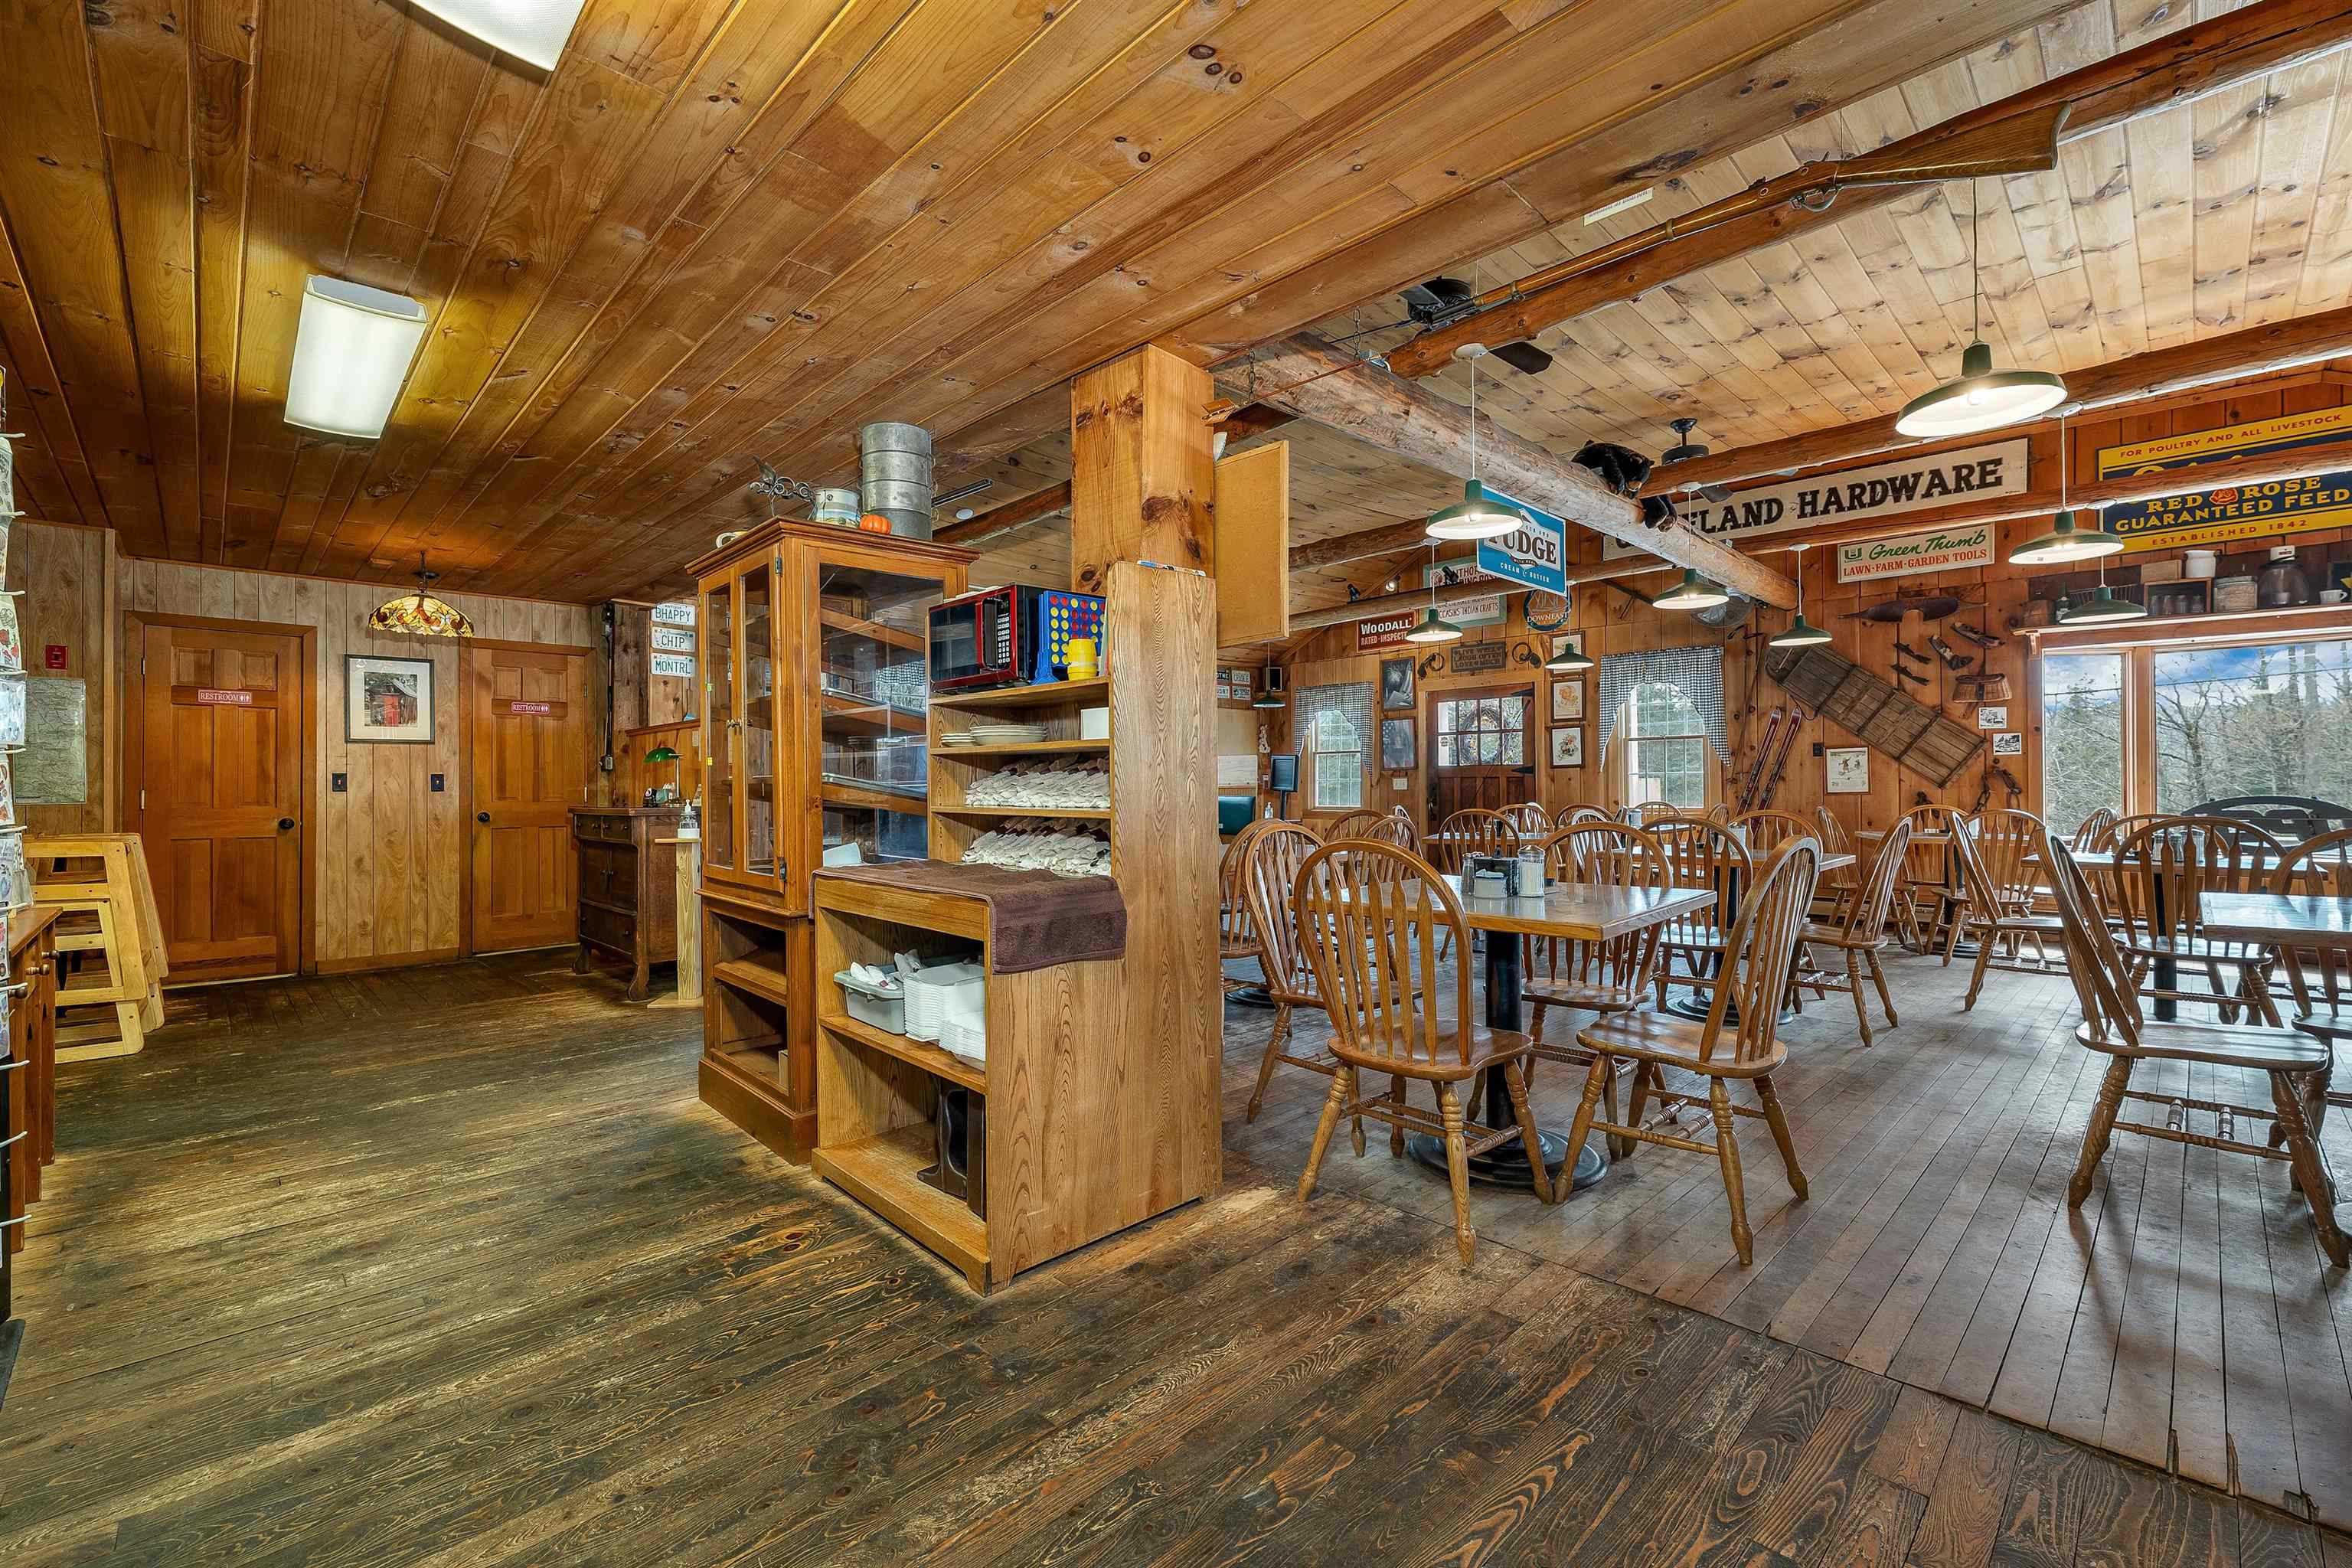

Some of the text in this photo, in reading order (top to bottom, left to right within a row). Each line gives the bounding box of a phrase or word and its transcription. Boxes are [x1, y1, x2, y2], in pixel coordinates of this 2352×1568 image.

[2120, 413, 2341, 458] FOR POULTRY AND ALL LIVESTOCK
[1797, 456, 2004, 520] HARDWARE
[2146, 476, 2322, 514] RED ROSE
[2115, 488, 2350, 531] GUARANTEED FEED
[2152, 519, 2308, 546] ESTABLISHED 1842
[1488, 529, 1557, 565] UDGE
[1869, 529, 1987, 560] Green Thumb
[1953, 548, 1988, 563] TOOLS
[1501, 563, 1520, 573] CREAM
[1530, 572, 1550, 582] BUTTER
[655, 607, 691, 622] BHAPPY
[1480, 602, 1499, 613] CRAFTS
[1527, 612, 1568, 622] DOWNEAST
[1361, 619, 1413, 635] WOODALL
[662, 635, 686, 648] CHIP
[655, 660, 691, 674] MONTRL
[201, 692, 240, 701] RESTROOM
